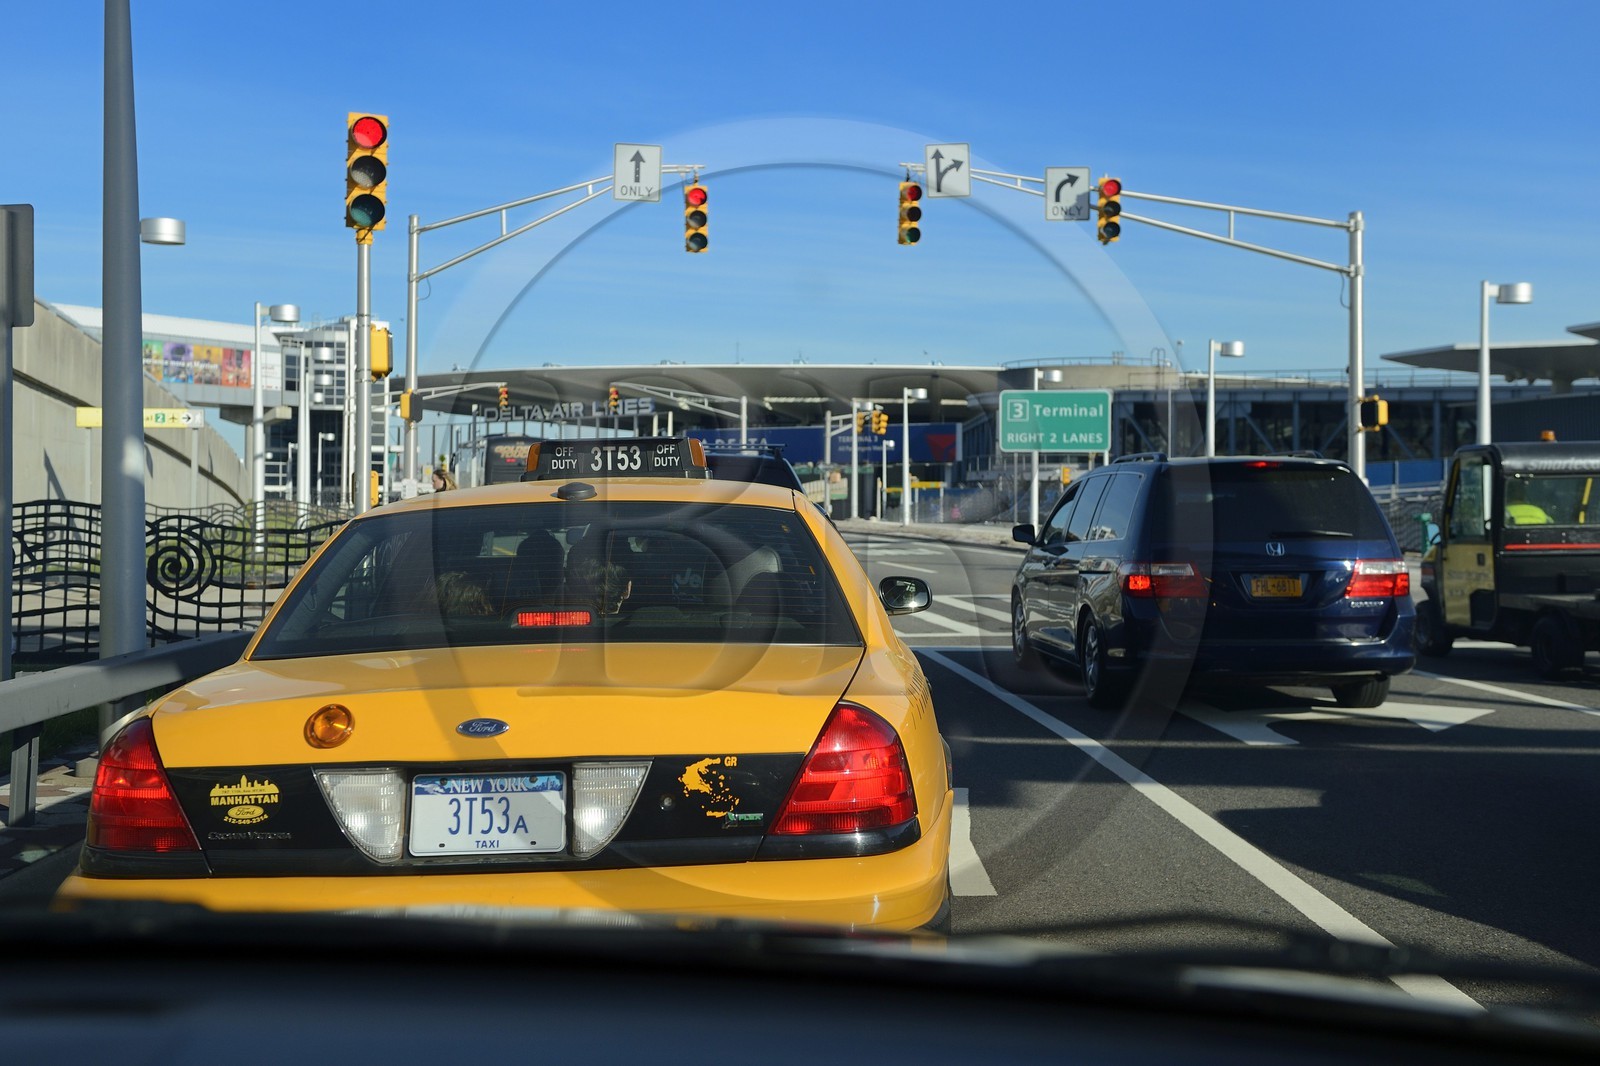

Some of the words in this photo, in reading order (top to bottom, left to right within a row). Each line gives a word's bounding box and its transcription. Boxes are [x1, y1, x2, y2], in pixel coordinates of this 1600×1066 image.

[620, 185, 653, 197] ONLY
[1052, 206, 1084, 216] ONLY
[484, 405, 544, 421] DELTA
[550, 402, 584, 418] AIR
[592, 397, 654, 416] LINES
[1013, 403, 1024, 418] 3
[1033, 404, 1103, 417] Terminal
[1007, 433, 1045, 443] RIGHT
[1049, 433, 1058, 443] 2
[1062, 433, 1103, 443] LANES
[656, 444, 675, 454] OFF
[715, 438, 769, 451] DETA
[555, 447, 574, 457] OFF
[590, 445, 641, 471] 3T53
[654, 457, 680, 467] DUTY
[551, 459, 577, 470] DUTY
[468, 721, 497, 732] Ford
[724, 756, 738, 767] GR
[450, 778, 484, 793] NEW
[486, 776, 528, 792] YORK
[210, 794, 278, 805] MANHATTAN
[235, 807, 256, 816] Ford
[475, 840, 500, 848] TAXI
